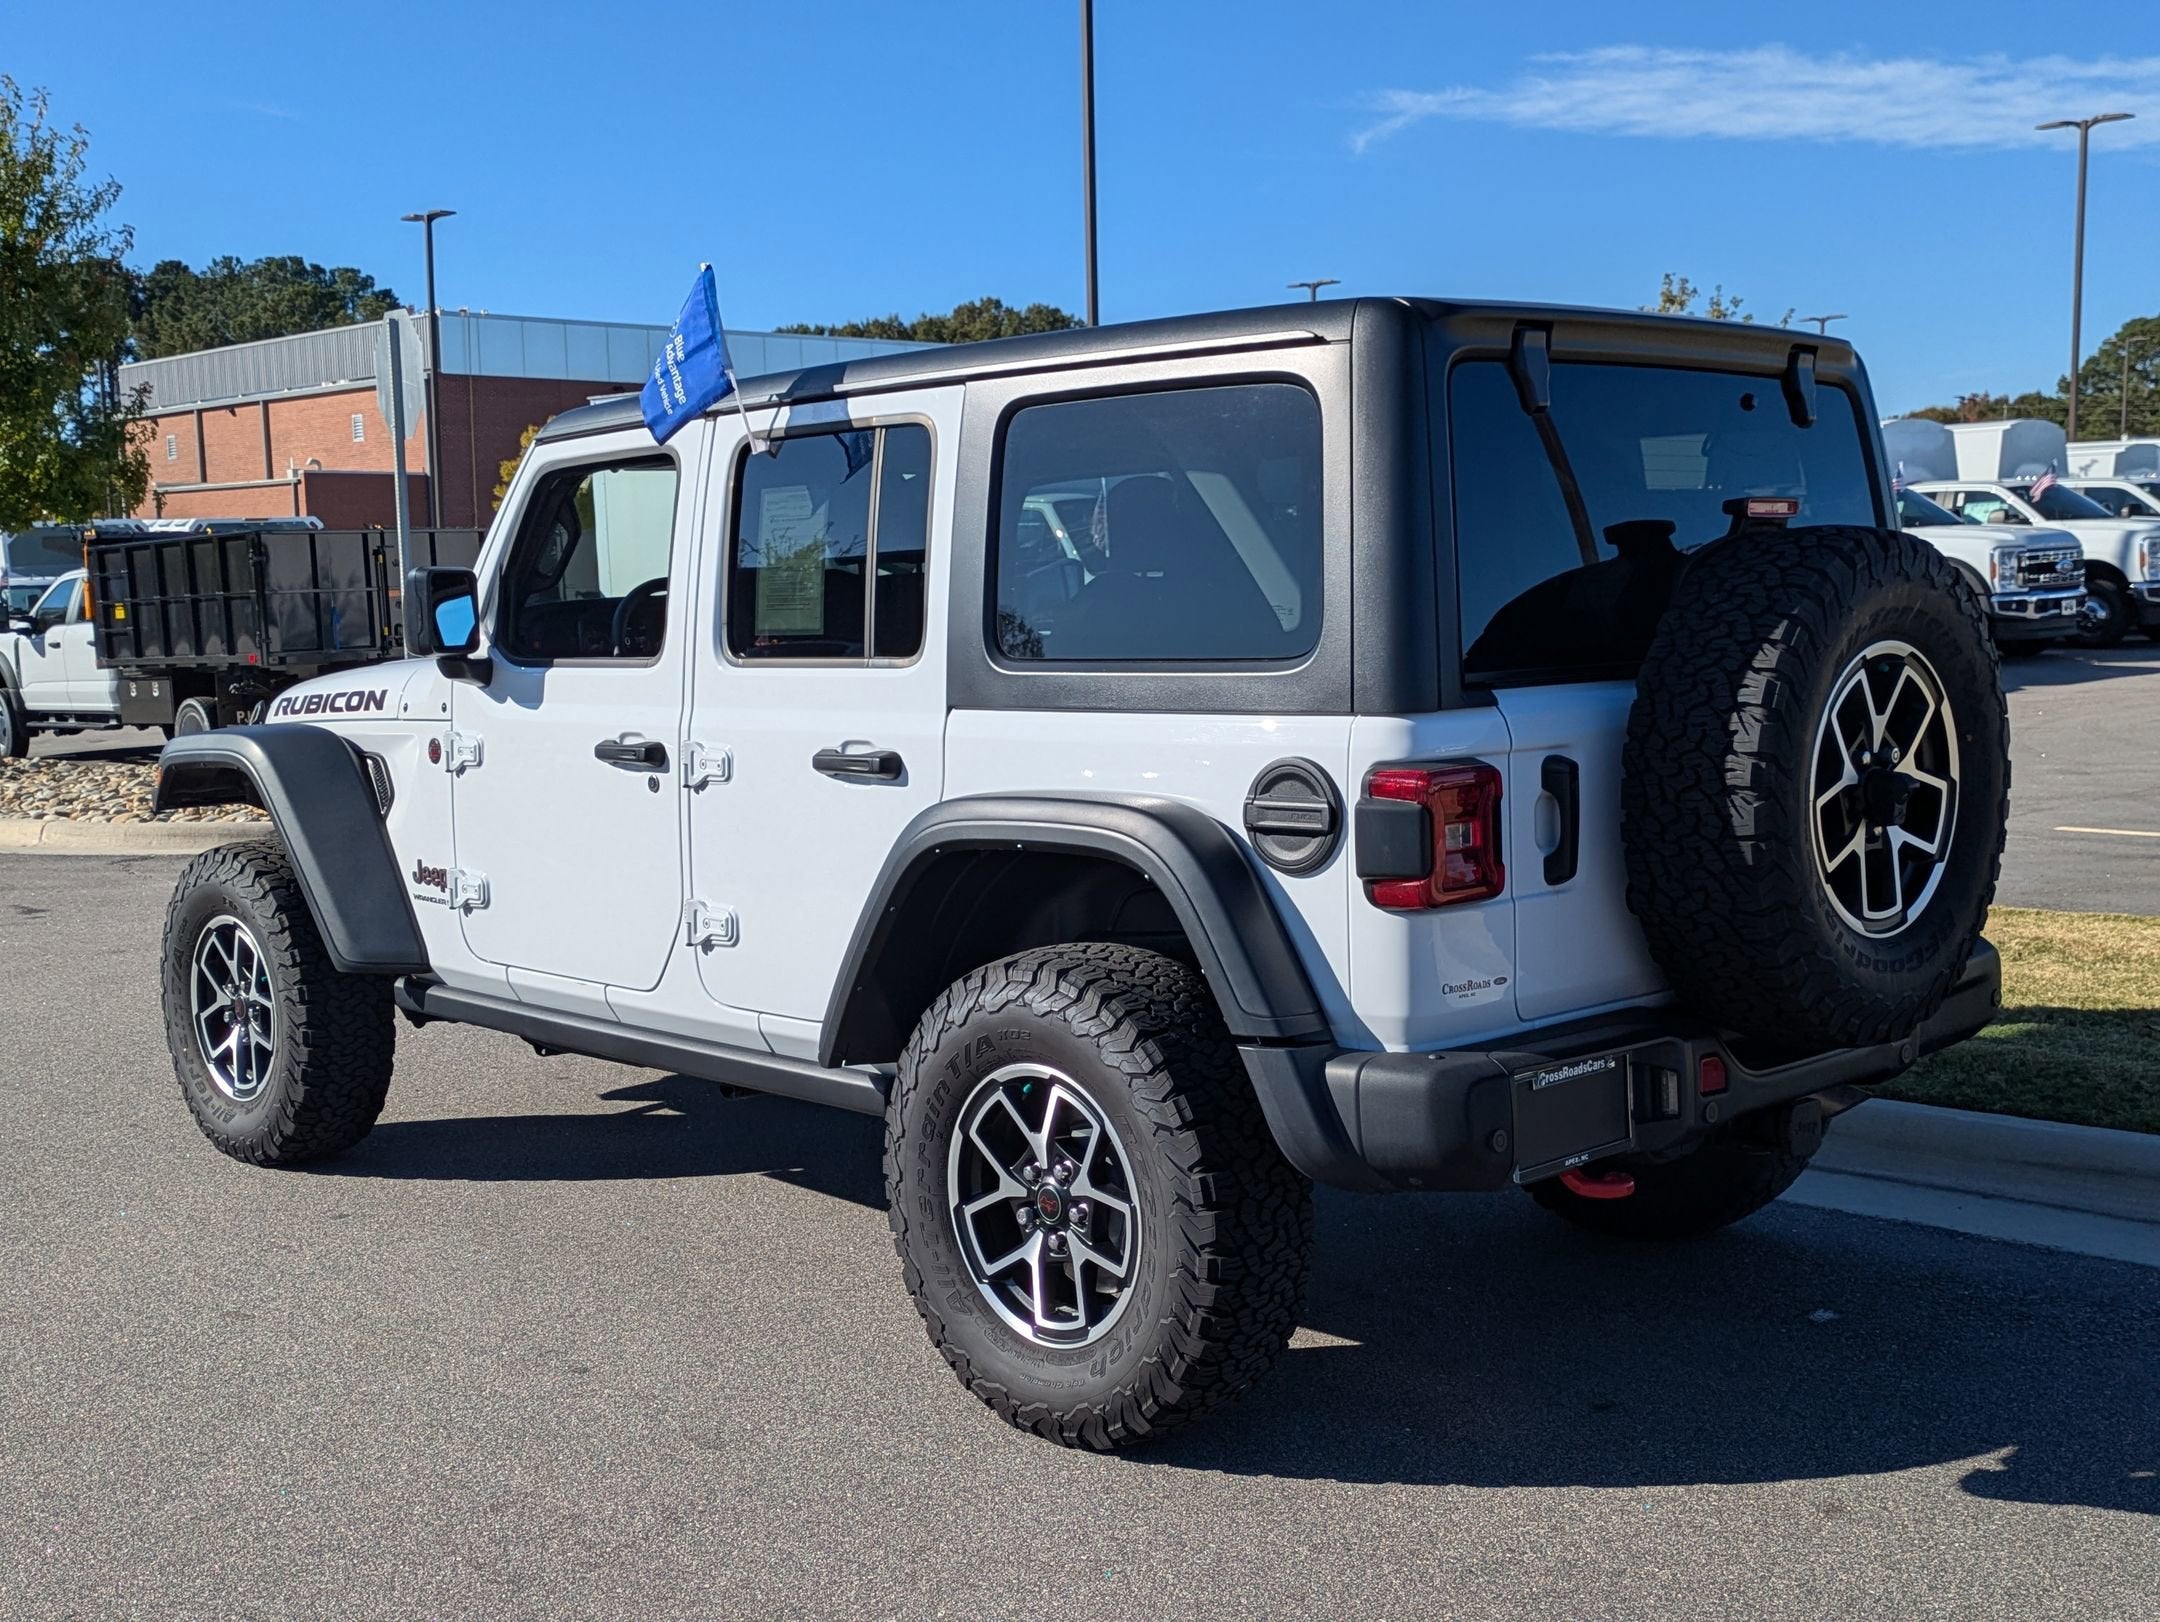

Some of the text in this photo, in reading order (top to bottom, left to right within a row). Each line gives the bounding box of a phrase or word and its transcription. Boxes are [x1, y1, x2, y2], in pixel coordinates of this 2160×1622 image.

[674, 334, 685, 363] Blue
[665, 343, 687, 405] Advantage
[660, 383, 673, 416] Vehicle
[274, 689, 389, 717] RUBICON
[412, 859, 448, 893] Jeep
[413, 893, 447, 906] WRANGLER
[1539, 1058, 1606, 1085] CrossRoadsCars
